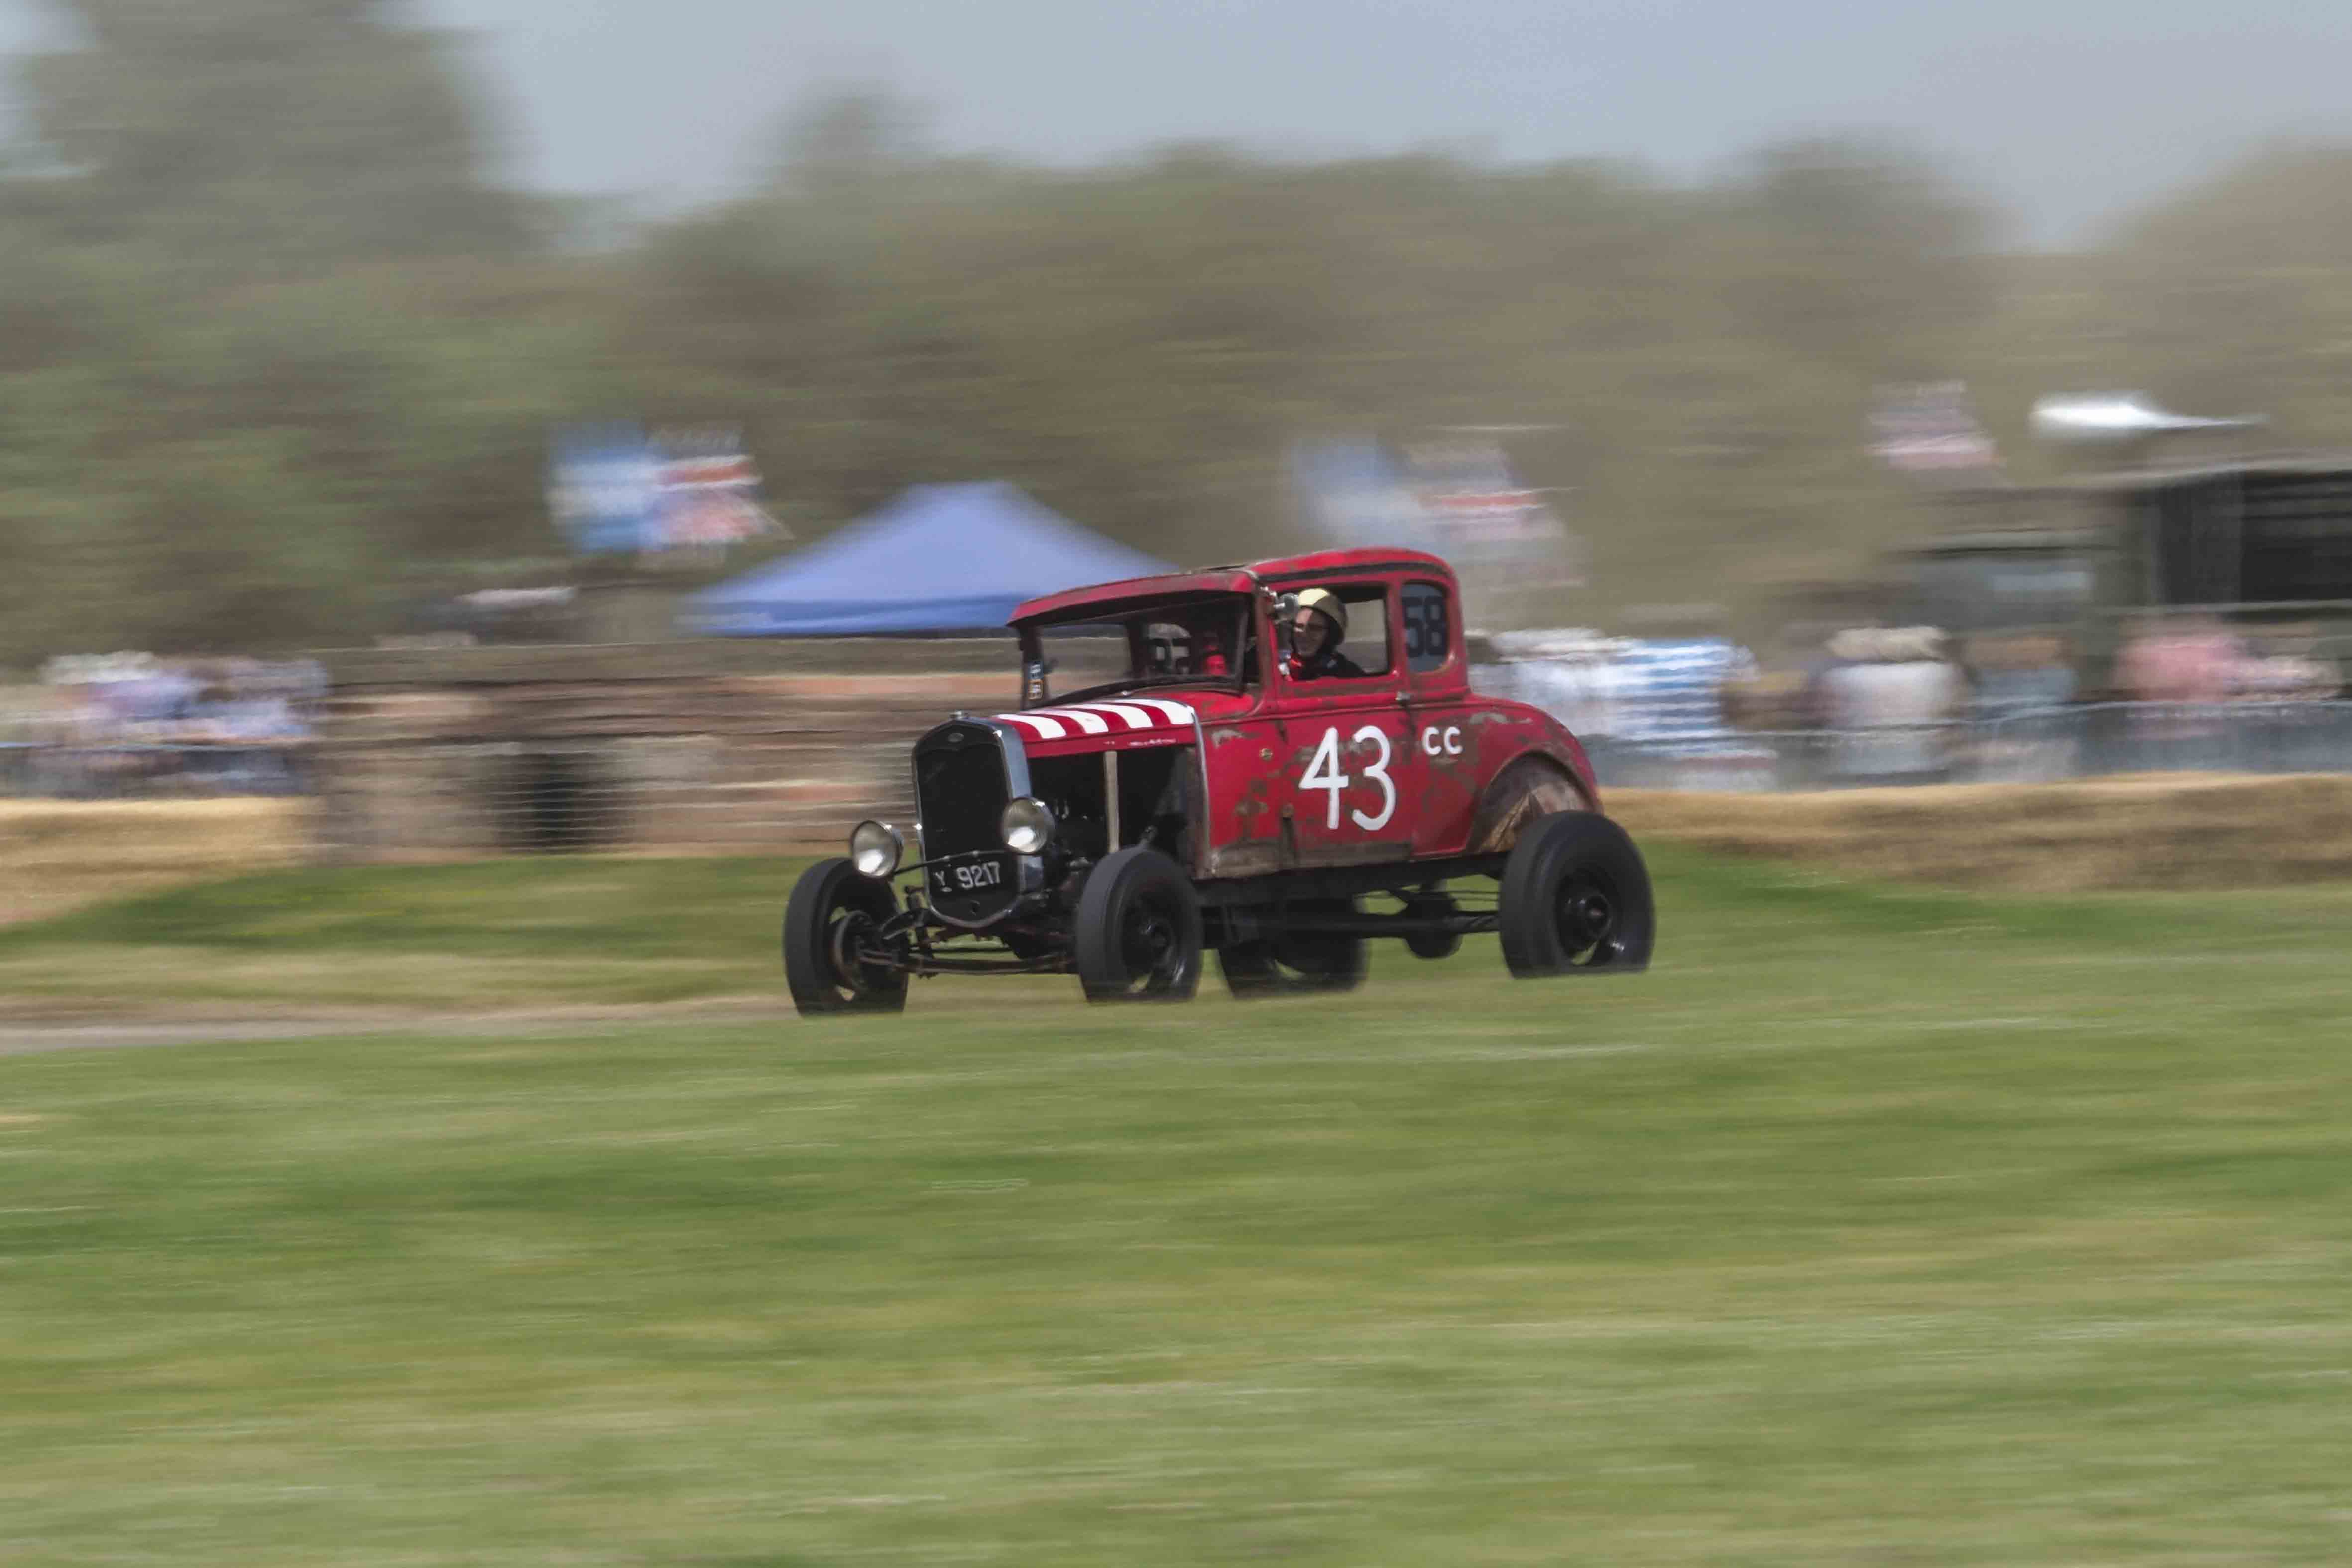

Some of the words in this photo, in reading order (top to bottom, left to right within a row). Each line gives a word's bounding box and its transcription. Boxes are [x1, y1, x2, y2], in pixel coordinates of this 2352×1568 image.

[1403, 596, 1446, 657] 58
[1299, 726, 1395, 830] 43
[956, 861, 1000, 889] 9217
